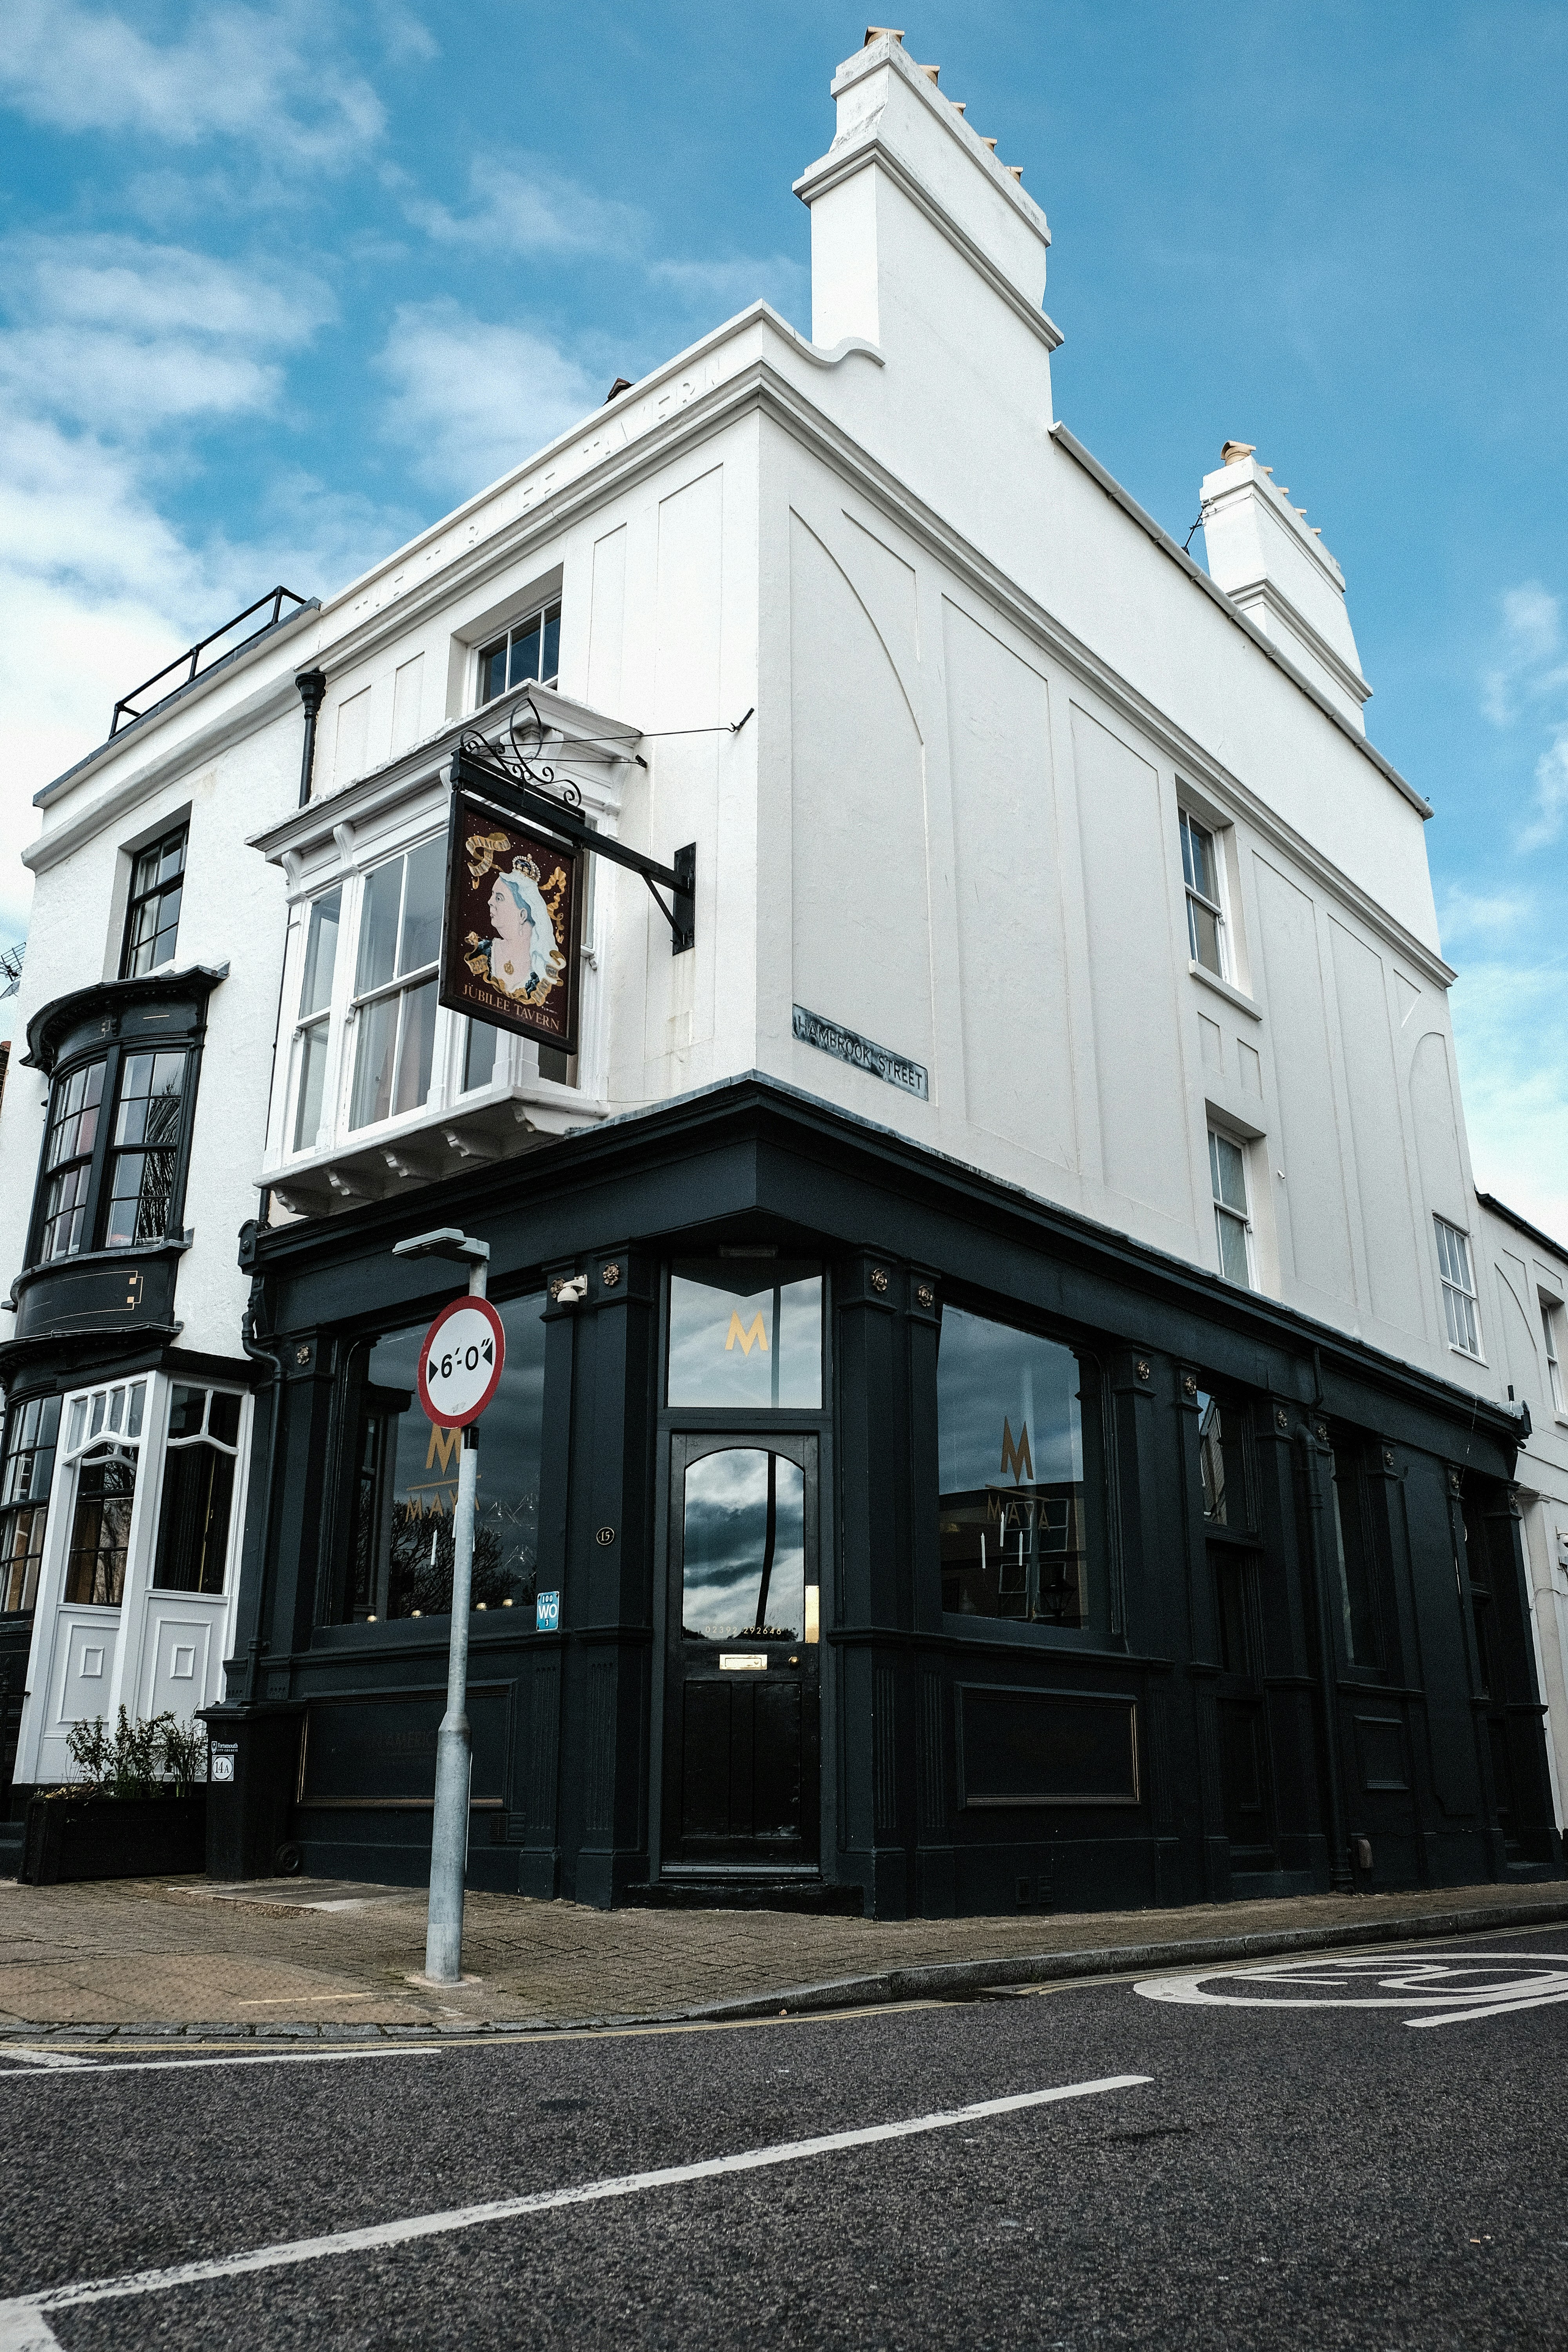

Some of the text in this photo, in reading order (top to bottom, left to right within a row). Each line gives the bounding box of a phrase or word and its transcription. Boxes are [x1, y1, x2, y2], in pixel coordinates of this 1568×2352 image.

[463, 984, 510, 1011] JUBILEE
[514, 1004, 559, 1031] TAVERN
[796, 1014, 922, 1090] HAMBROOK STREET
[725, 1309, 769, 1356] M
[426, 1423, 462, 1476] M
[1000, 1416, 1034, 1486] M
[601, 1531, 610, 1541] 15
[538, 1604, 557, 1619] WO
[542, 1595, 553, 1603] 100
[215, 1761, 229, 1773] 14A
